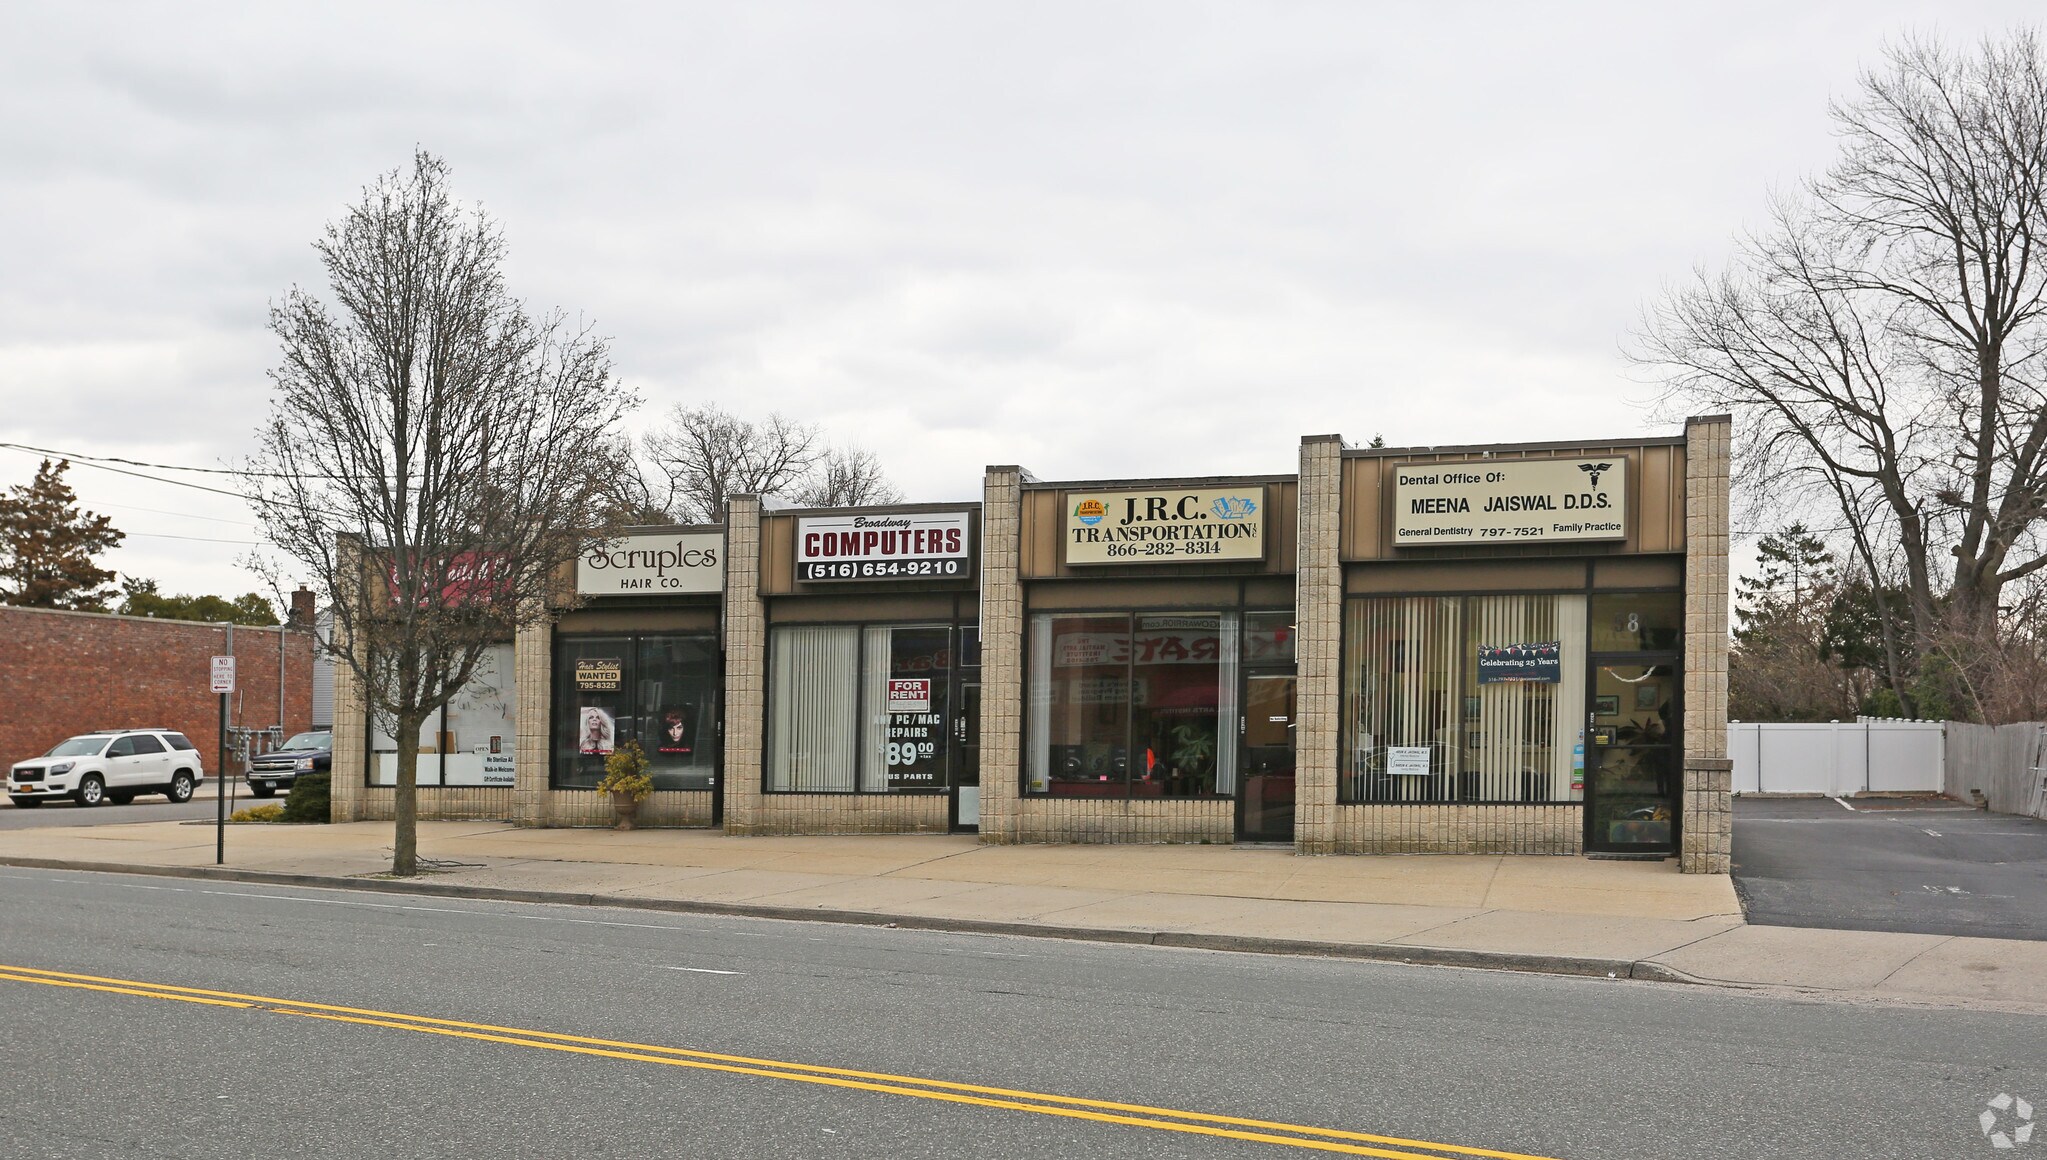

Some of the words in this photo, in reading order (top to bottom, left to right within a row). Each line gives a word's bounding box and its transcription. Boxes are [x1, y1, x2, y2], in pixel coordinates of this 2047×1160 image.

[1399, 474, 1439, 486] Dental
[1443, 473, 1481, 484] Office
[1486, 472, 1506, 483] Of:
[1120, 495, 1208, 526] J.R.C.
[1411, 497, 1471, 514] MEENA
[1484, 494, 1557, 512] JAISWAL
[1563, 493, 1612, 510] D.D.S.
[853, 517, 912, 530] Broadway
[1398, 528, 1432, 537] General
[1433, 527, 1474, 537] Dentistry
[1480, 527, 1544, 537] 797-7521
[1553, 523, 1583, 533] Family
[1584, 521, 1622, 532] Practice
[1072, 522, 1252, 543] TRANSPORTATION
[804, 528, 961, 557] COMPUTERS
[1107, 541, 1221, 557] 866-282-8314
[588, 541, 717, 577] Scruples
[807, 562, 859, 579] (516)
[862, 561, 958, 576] 654-9210
[620, 578, 652, 589] HAIR
[660, 577, 683, 588] CO.
[577, 661, 594, 670] Hair
[596, 660, 620, 672] Stylist
[1480, 658, 1524, 668] Celebrating
[1537, 657, 1559, 666] Years
[578, 672, 618, 680] WANTED
[894, 681, 922, 690] FOR
[890, 690, 927, 699] RENT
[885, 727, 928, 738] REPAIRS
